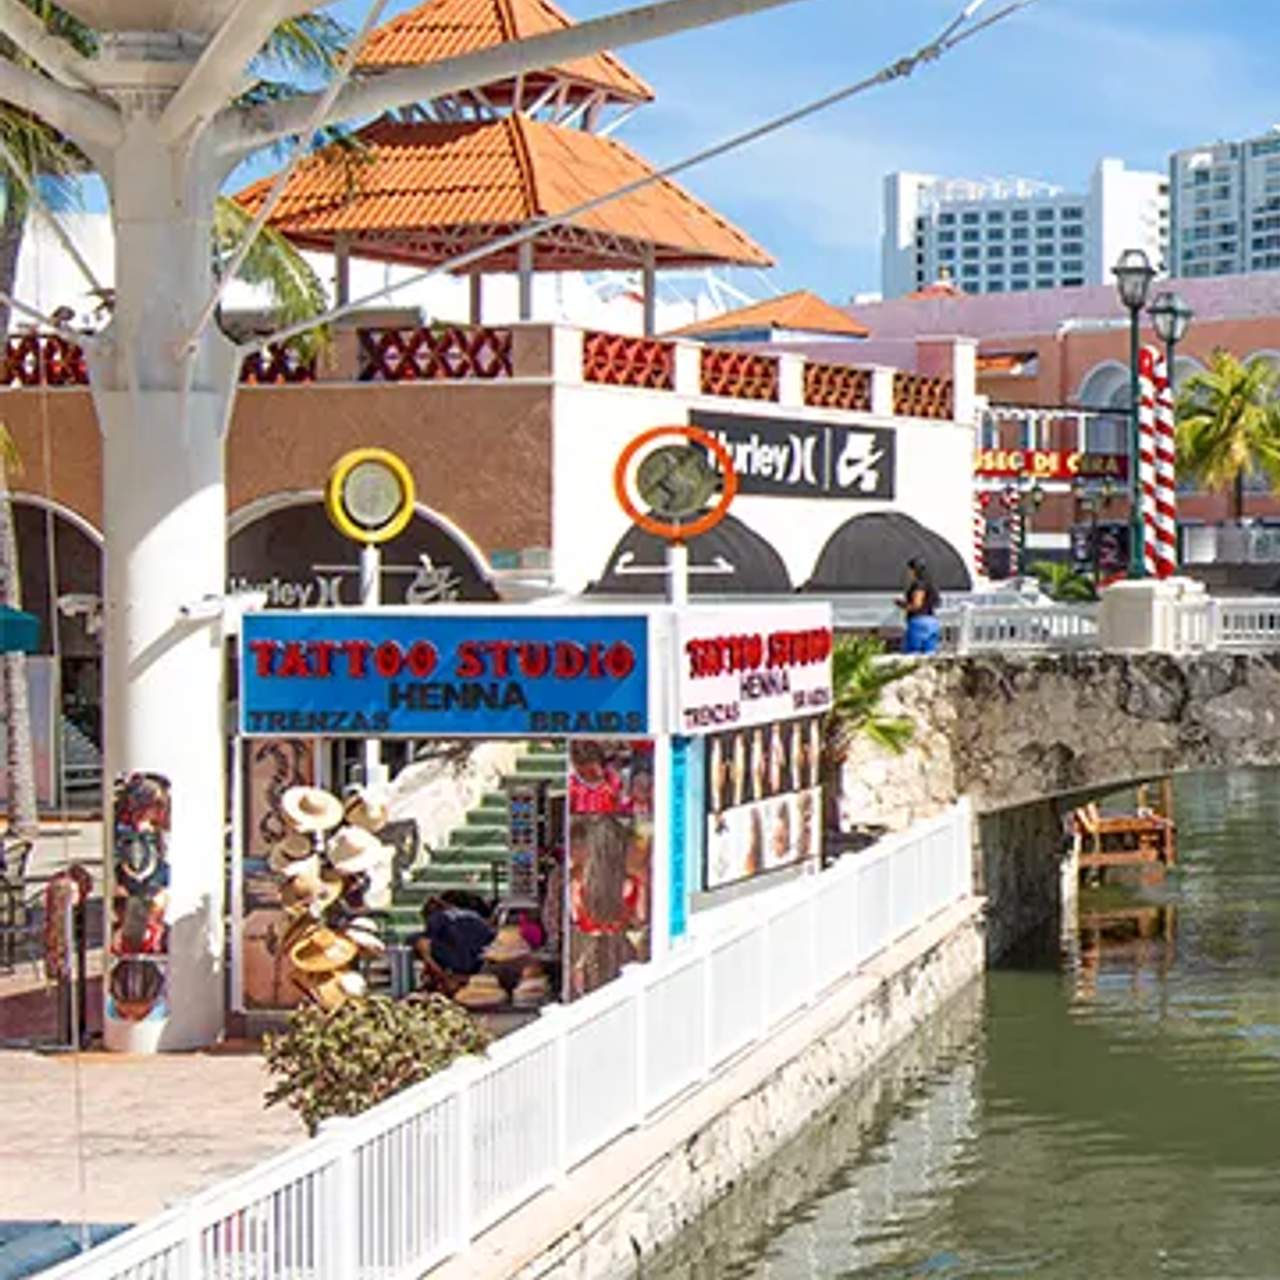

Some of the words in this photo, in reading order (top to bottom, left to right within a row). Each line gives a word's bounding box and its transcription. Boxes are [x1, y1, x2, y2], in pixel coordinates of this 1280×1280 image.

[248, 638, 437, 680] TATTOO
[455, 638, 638, 680] STUDIO
[685, 633, 763, 679] TATTOO
[389, 681, 530, 712] HENNA
[740, 671, 791, 700] HENNA
[249, 709, 390, 733] TRENZAS
[529, 709, 645, 733] BRAIDS
